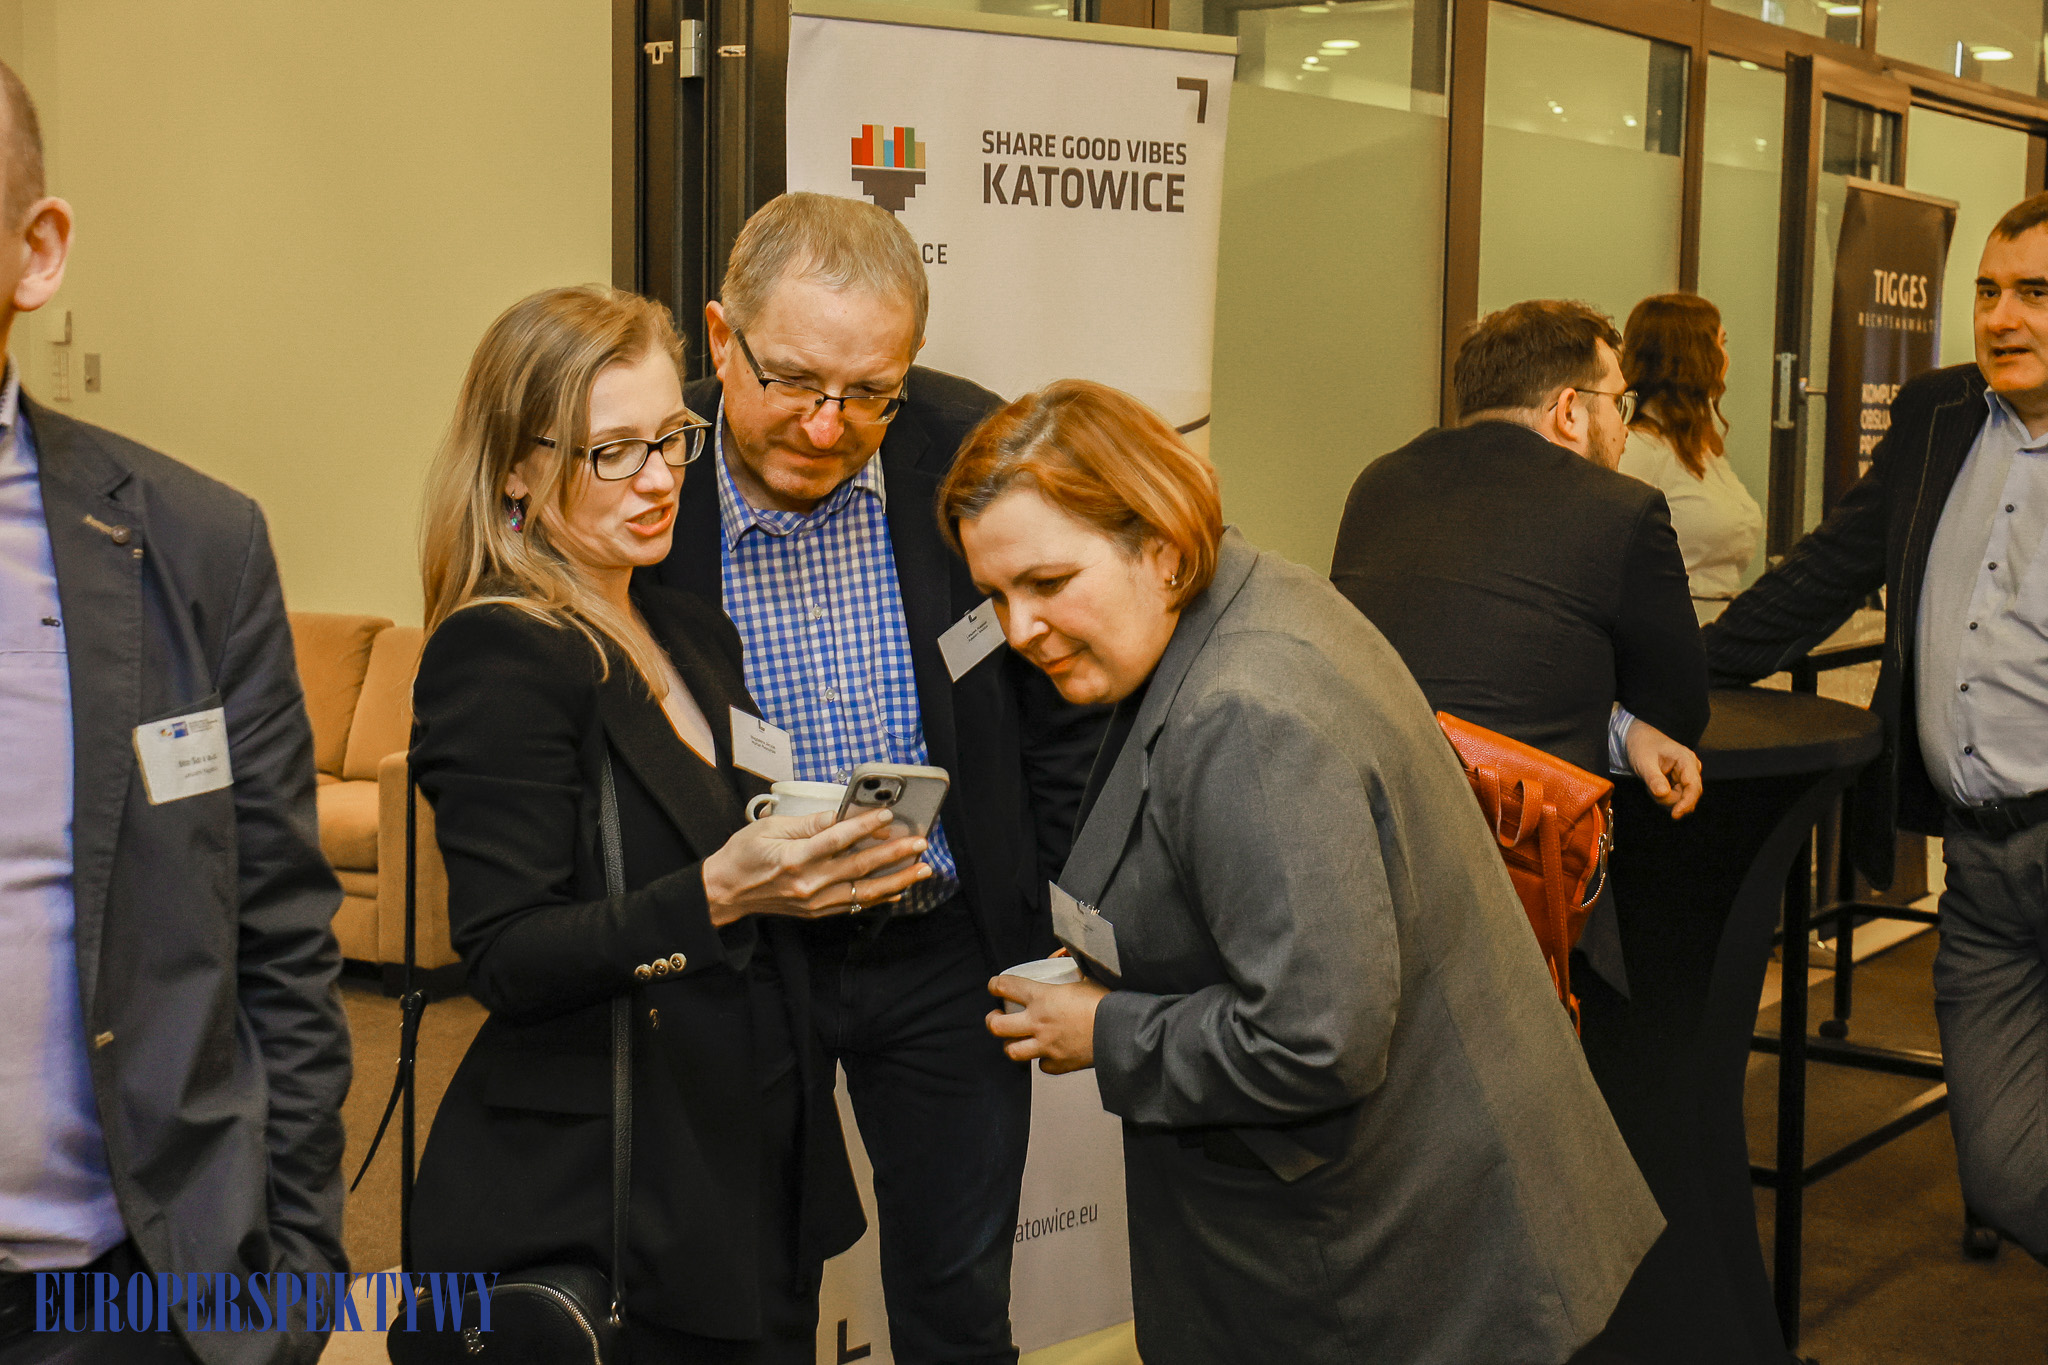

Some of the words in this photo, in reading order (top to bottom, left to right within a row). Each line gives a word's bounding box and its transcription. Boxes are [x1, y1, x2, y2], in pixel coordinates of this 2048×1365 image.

[982, 129, 1056, 157] SHARE
[1062, 135, 1121, 162] GOOD
[1126, 140, 1187, 166] VIBES
[982, 162, 1186, 214] KATOWICE
[922, 242, 948, 265] CE
[1873, 268, 1928, 310] TIGGES
[1015, 1203, 1098, 1243] atowice.eu
